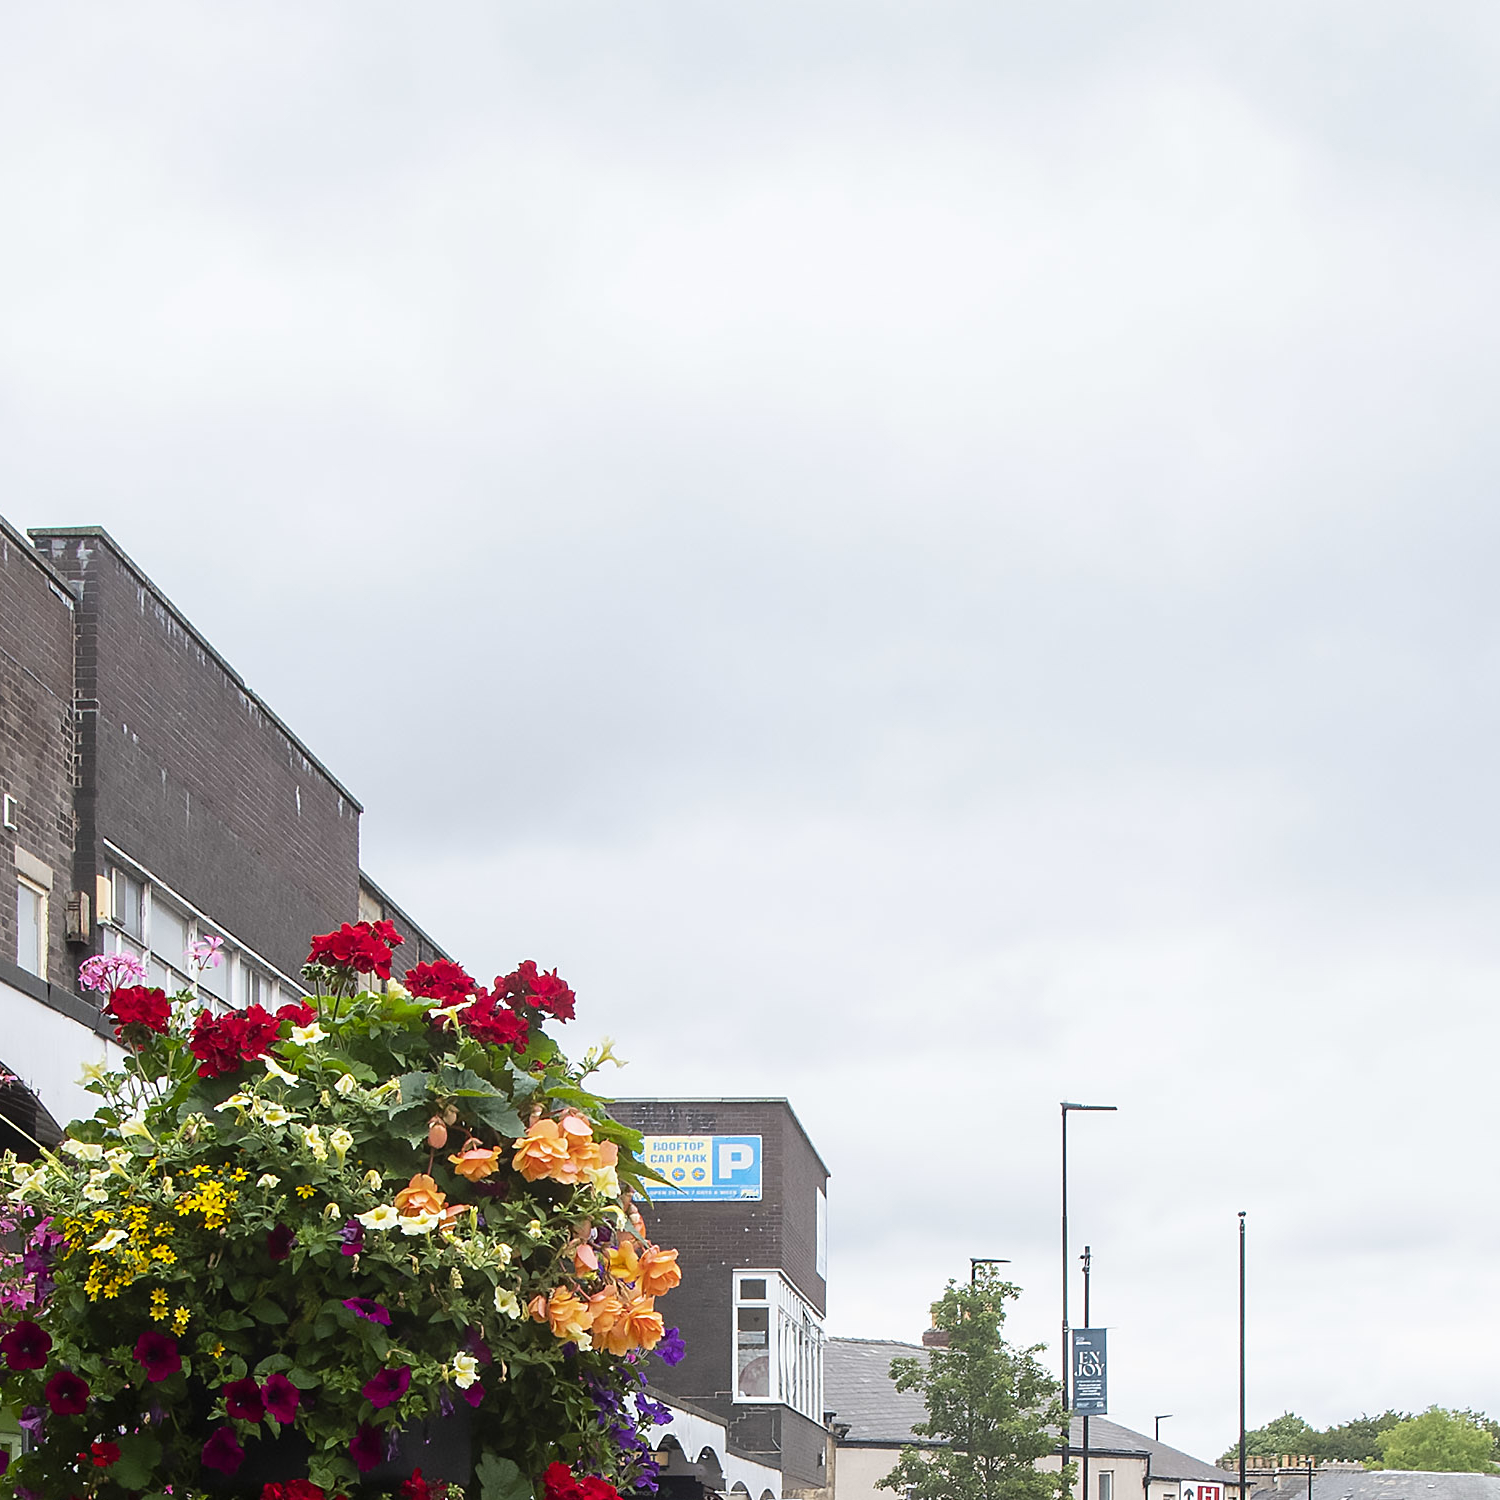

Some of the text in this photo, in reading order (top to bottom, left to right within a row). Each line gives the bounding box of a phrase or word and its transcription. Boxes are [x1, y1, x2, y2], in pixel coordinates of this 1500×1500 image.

[653, 1142, 705, 1152] ROOFTOP
[650, 1154, 707, 1163] CAR PARK
[1073, 1363, 1105, 1377] JOY
